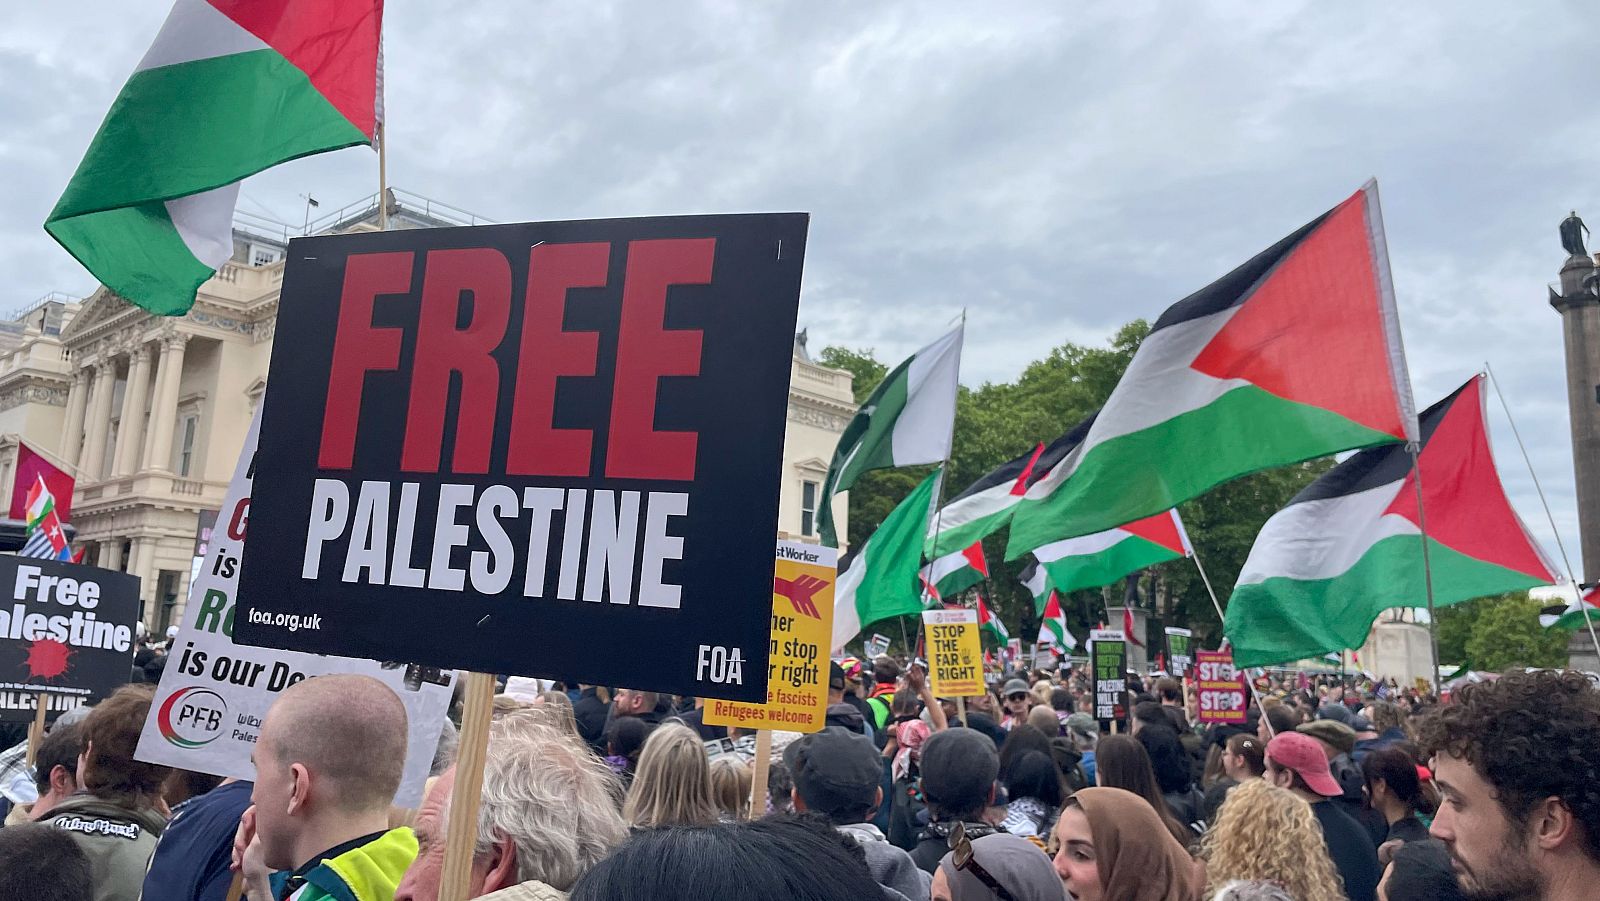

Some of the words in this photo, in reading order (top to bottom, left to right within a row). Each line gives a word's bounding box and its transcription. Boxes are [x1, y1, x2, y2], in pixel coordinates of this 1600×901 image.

[318, 237, 716, 481] FREE
[301, 478, 690, 610] PALESTINE
[212, 548, 238, 579] is
[14, 565, 101, 609] Free
[248, 607, 322, 632] foa.org.uk
[933, 625, 965, 638] STOP
[783, 638, 817, 664] stop
[934, 639, 958, 652] THE
[178, 641, 207, 677] is
[211, 656, 266, 688] our
[266, 661, 306, 693] De
[696, 645, 746, 685] FOA
[935, 653, 959, 666] FAR
[781, 660, 818, 687] right
[937, 666, 975, 680] RIGHT
[776, 689, 817, 706] fascists
[1200, 691, 1244, 710] STOP
[177, 704, 222, 732] PFB
[715, 701, 765, 721] Refugees
[768, 708, 813, 724] welcome
[231, 729, 259, 743] Pales
